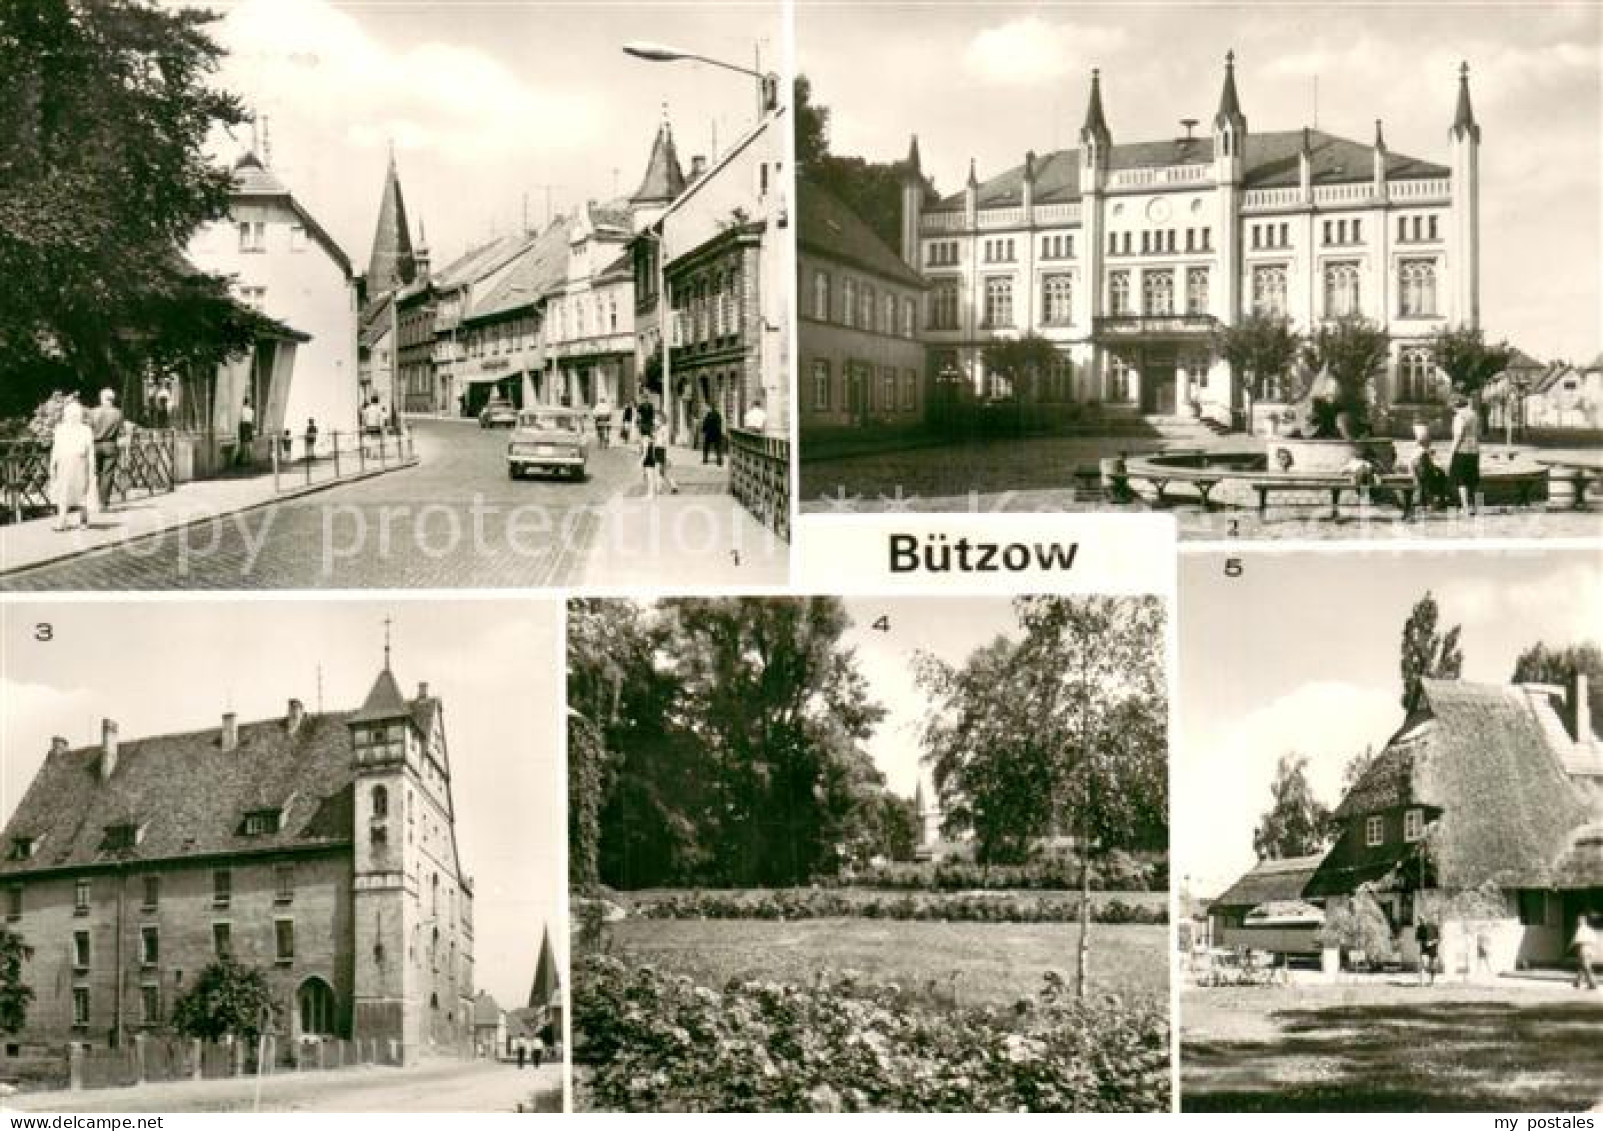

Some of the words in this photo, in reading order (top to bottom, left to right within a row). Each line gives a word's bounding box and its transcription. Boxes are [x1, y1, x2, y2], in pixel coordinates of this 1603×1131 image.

[889, 533, 1079, 573] Bützow
[1224, 558, 1242, 578] 5
[35, 622, 54, 642] 3
[872, 615, 891, 632] 4
